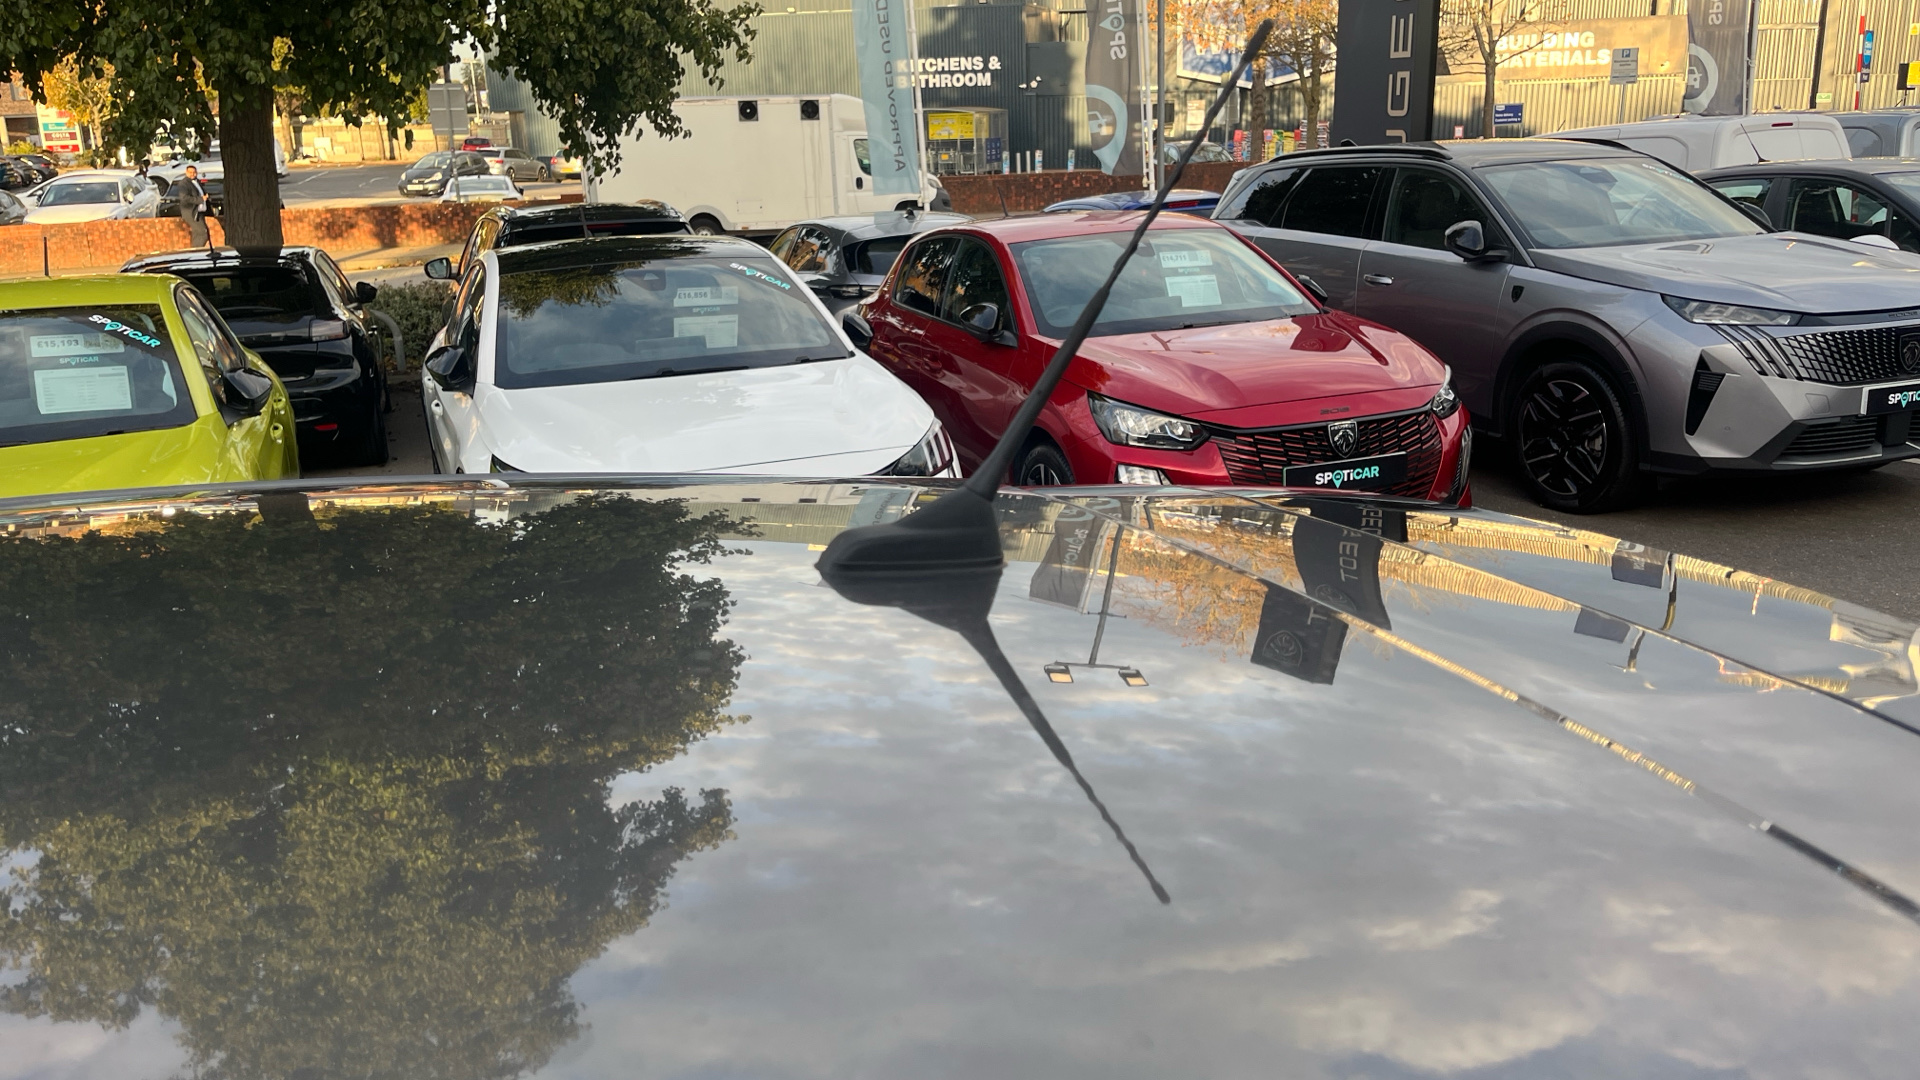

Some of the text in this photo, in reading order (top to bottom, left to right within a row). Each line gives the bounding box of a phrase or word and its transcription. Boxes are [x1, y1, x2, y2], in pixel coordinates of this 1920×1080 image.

[1495, 31, 1595, 51] BUILDING
[896, 56, 1001, 73] KITCHENS &
